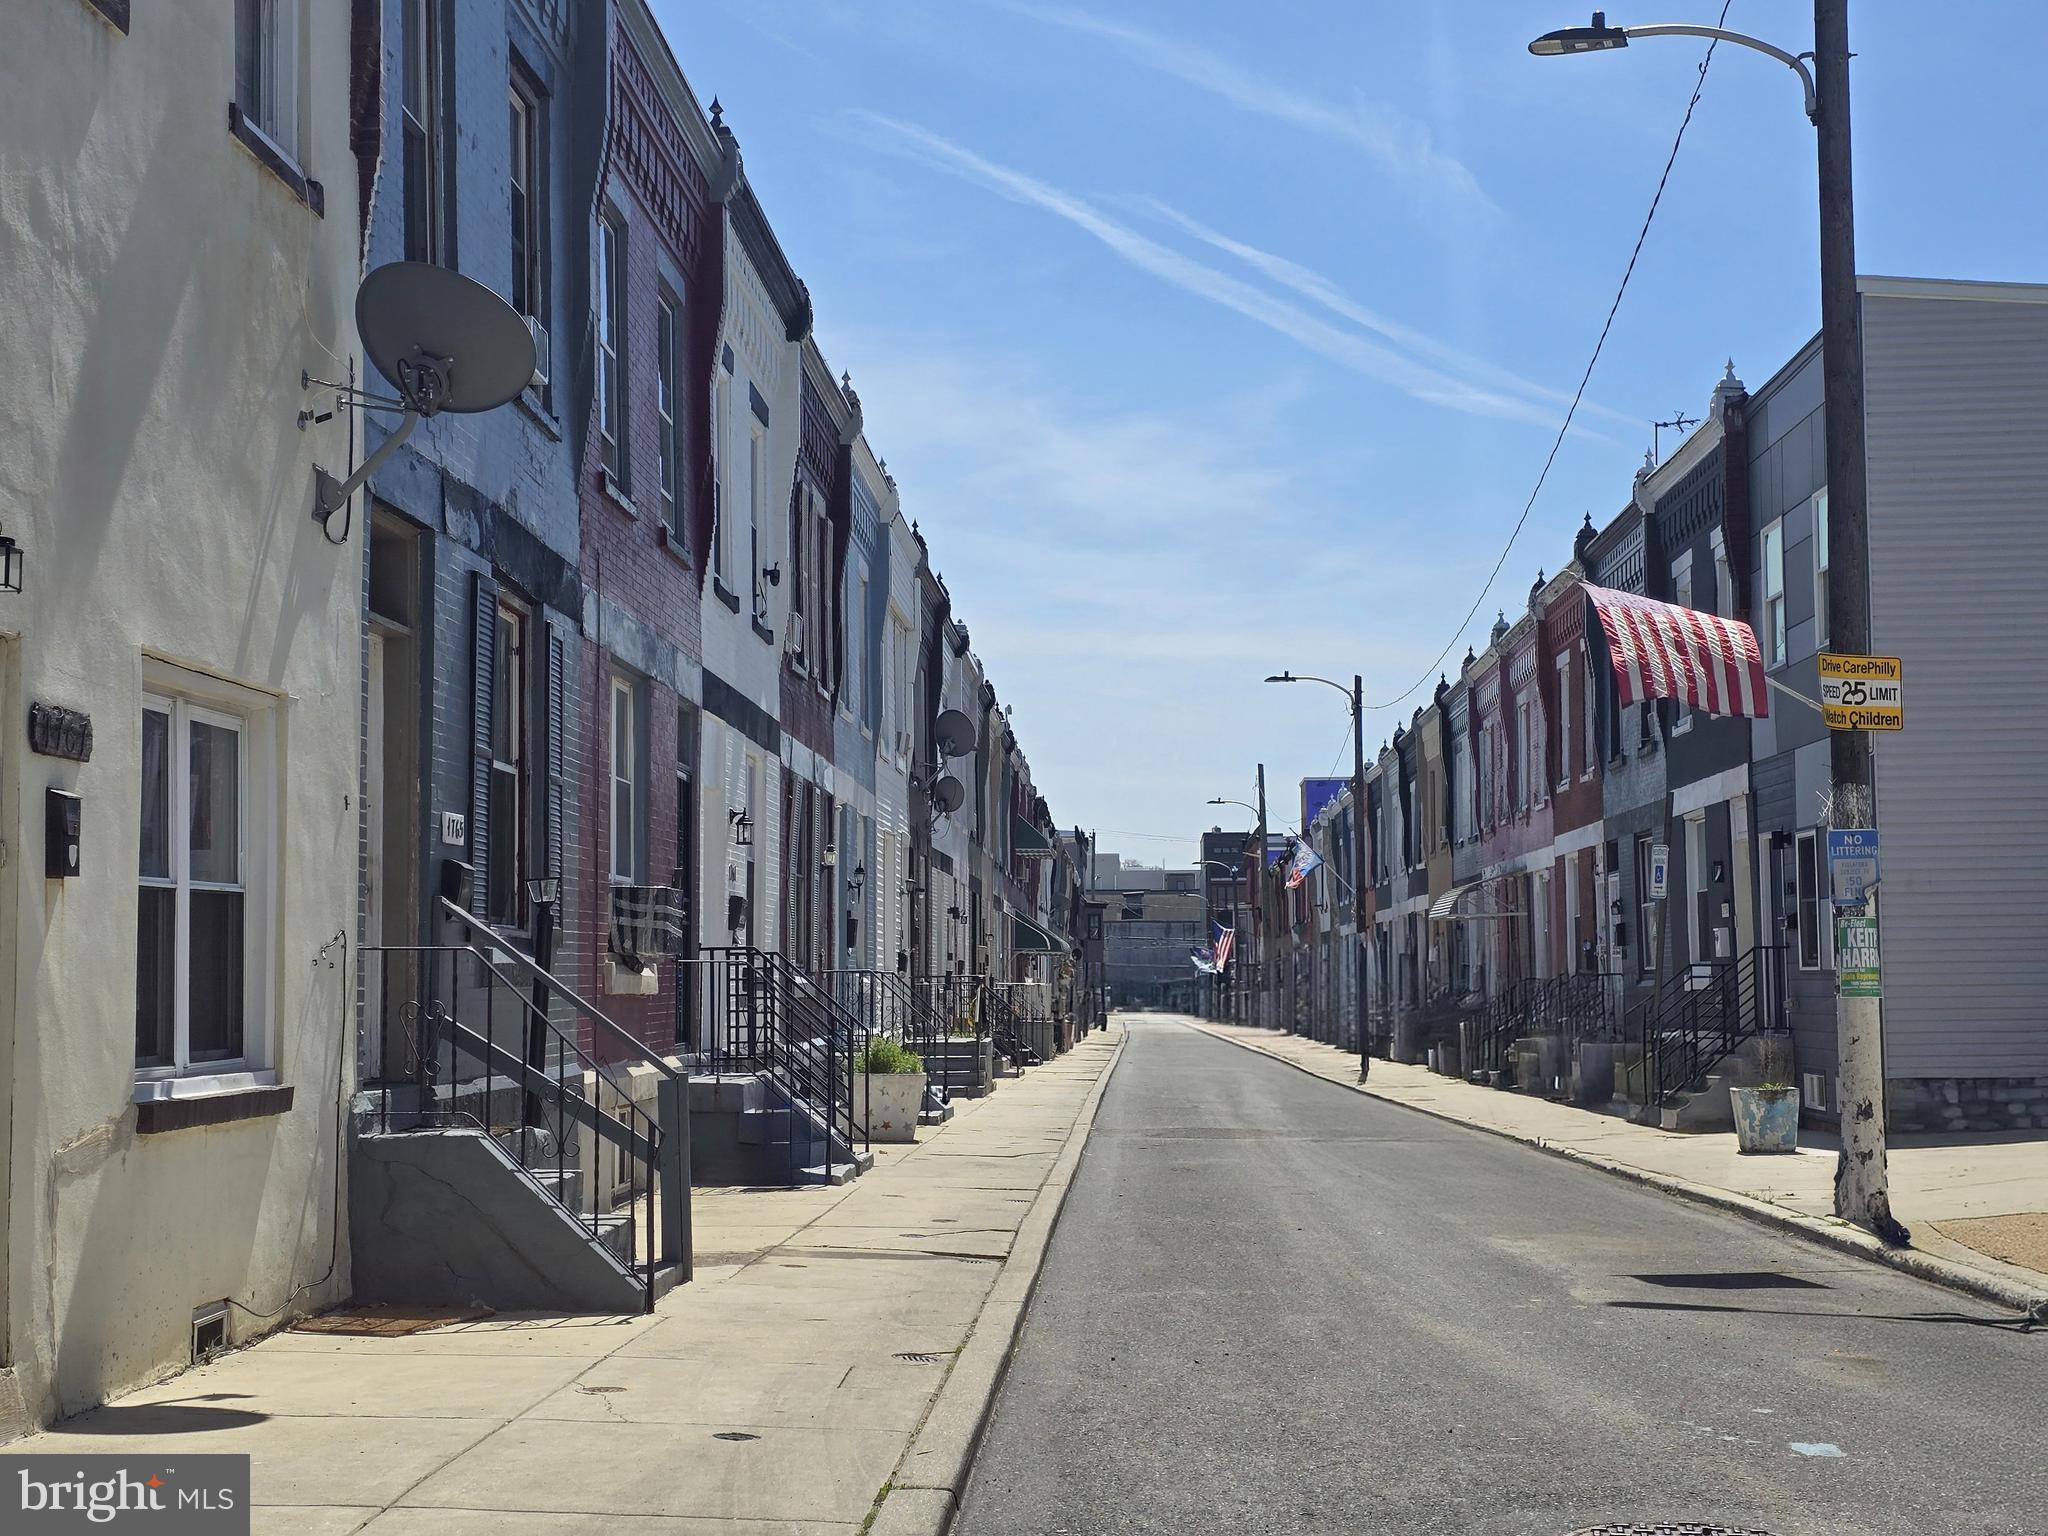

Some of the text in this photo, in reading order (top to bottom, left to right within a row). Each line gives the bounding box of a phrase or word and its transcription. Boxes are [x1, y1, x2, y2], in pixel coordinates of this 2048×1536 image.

[1822, 658, 1896, 677] Drive CarePhilly
[1823, 680, 1898, 705] SPEED 25 LIMIT
[1825, 709, 1900, 726] Watch Children
[1844, 835, 1863, 845] NO
[1831, 846, 1878, 856] LITTERING
[1844, 887, 1864, 897] FIN
